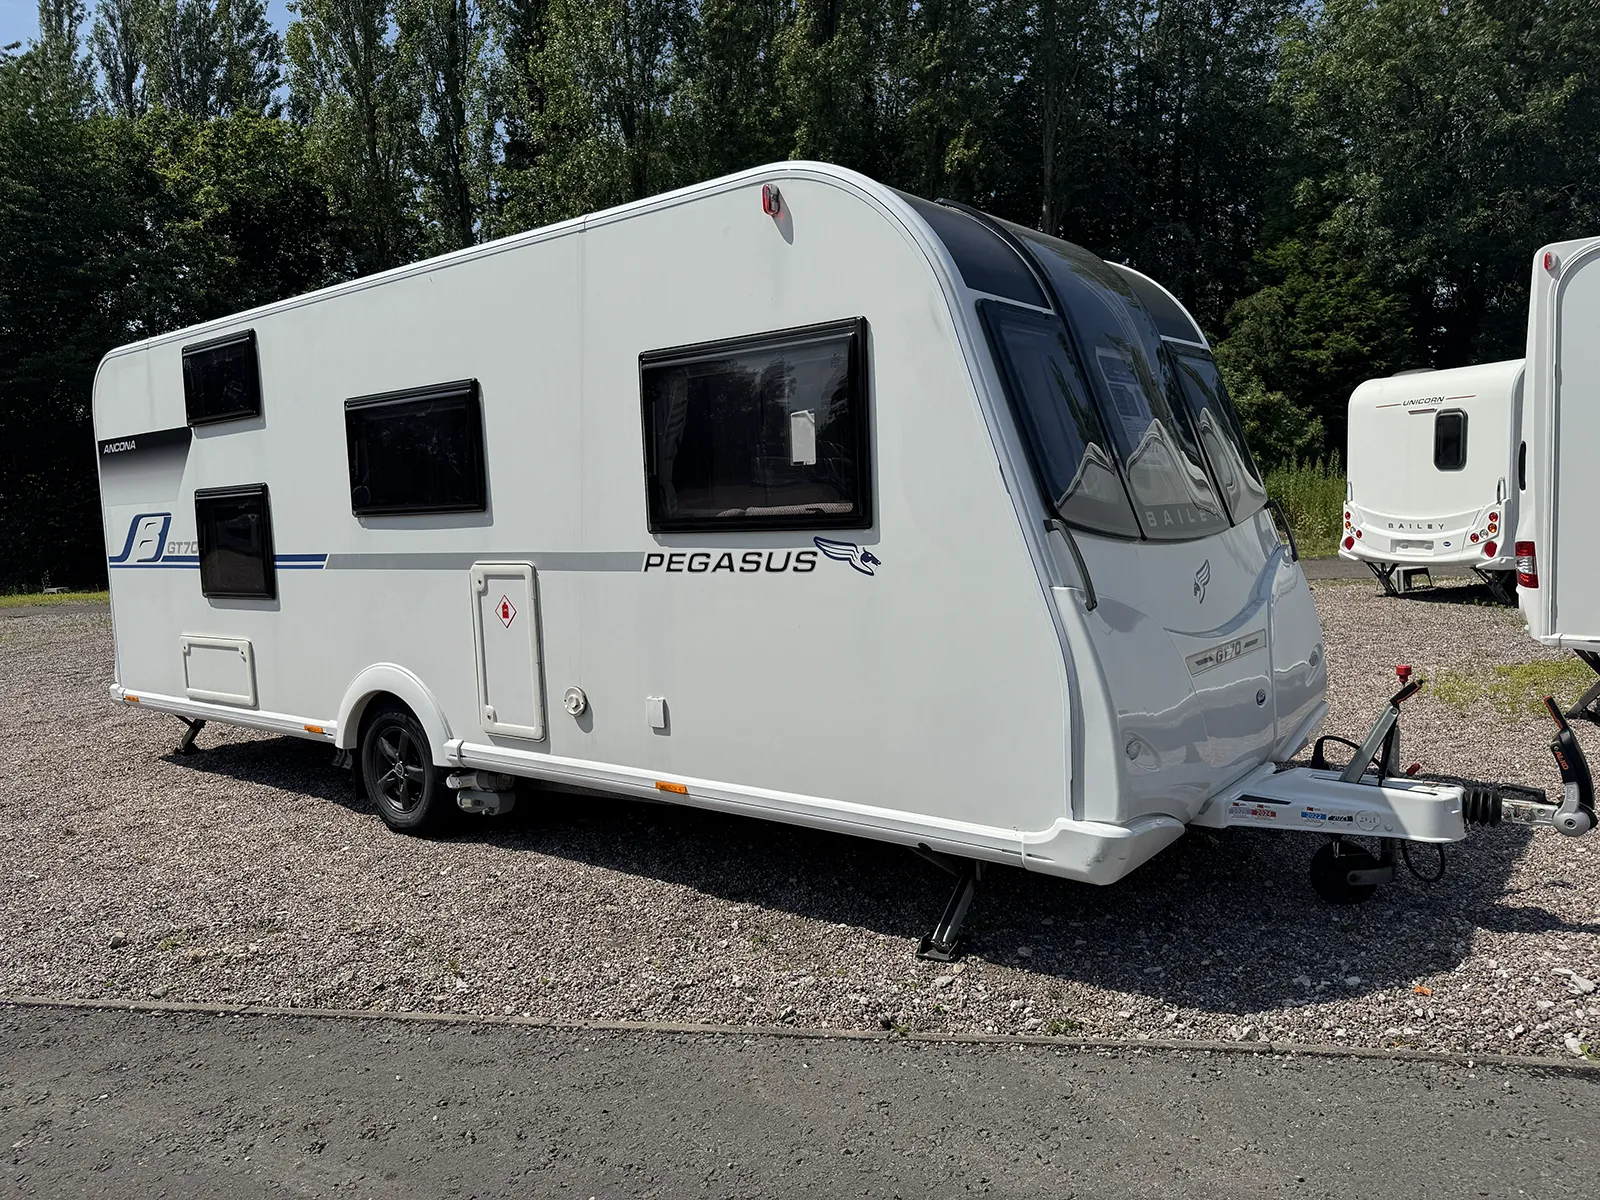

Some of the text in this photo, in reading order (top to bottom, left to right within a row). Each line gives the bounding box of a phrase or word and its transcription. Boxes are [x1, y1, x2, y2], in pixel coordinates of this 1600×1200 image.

[1402, 396, 1445, 406] UNICORN
[103, 440, 136, 454] ANCONA
[1388, 522, 1444, 530] BAILEY
[643, 551, 818, 573] PEGASUS
